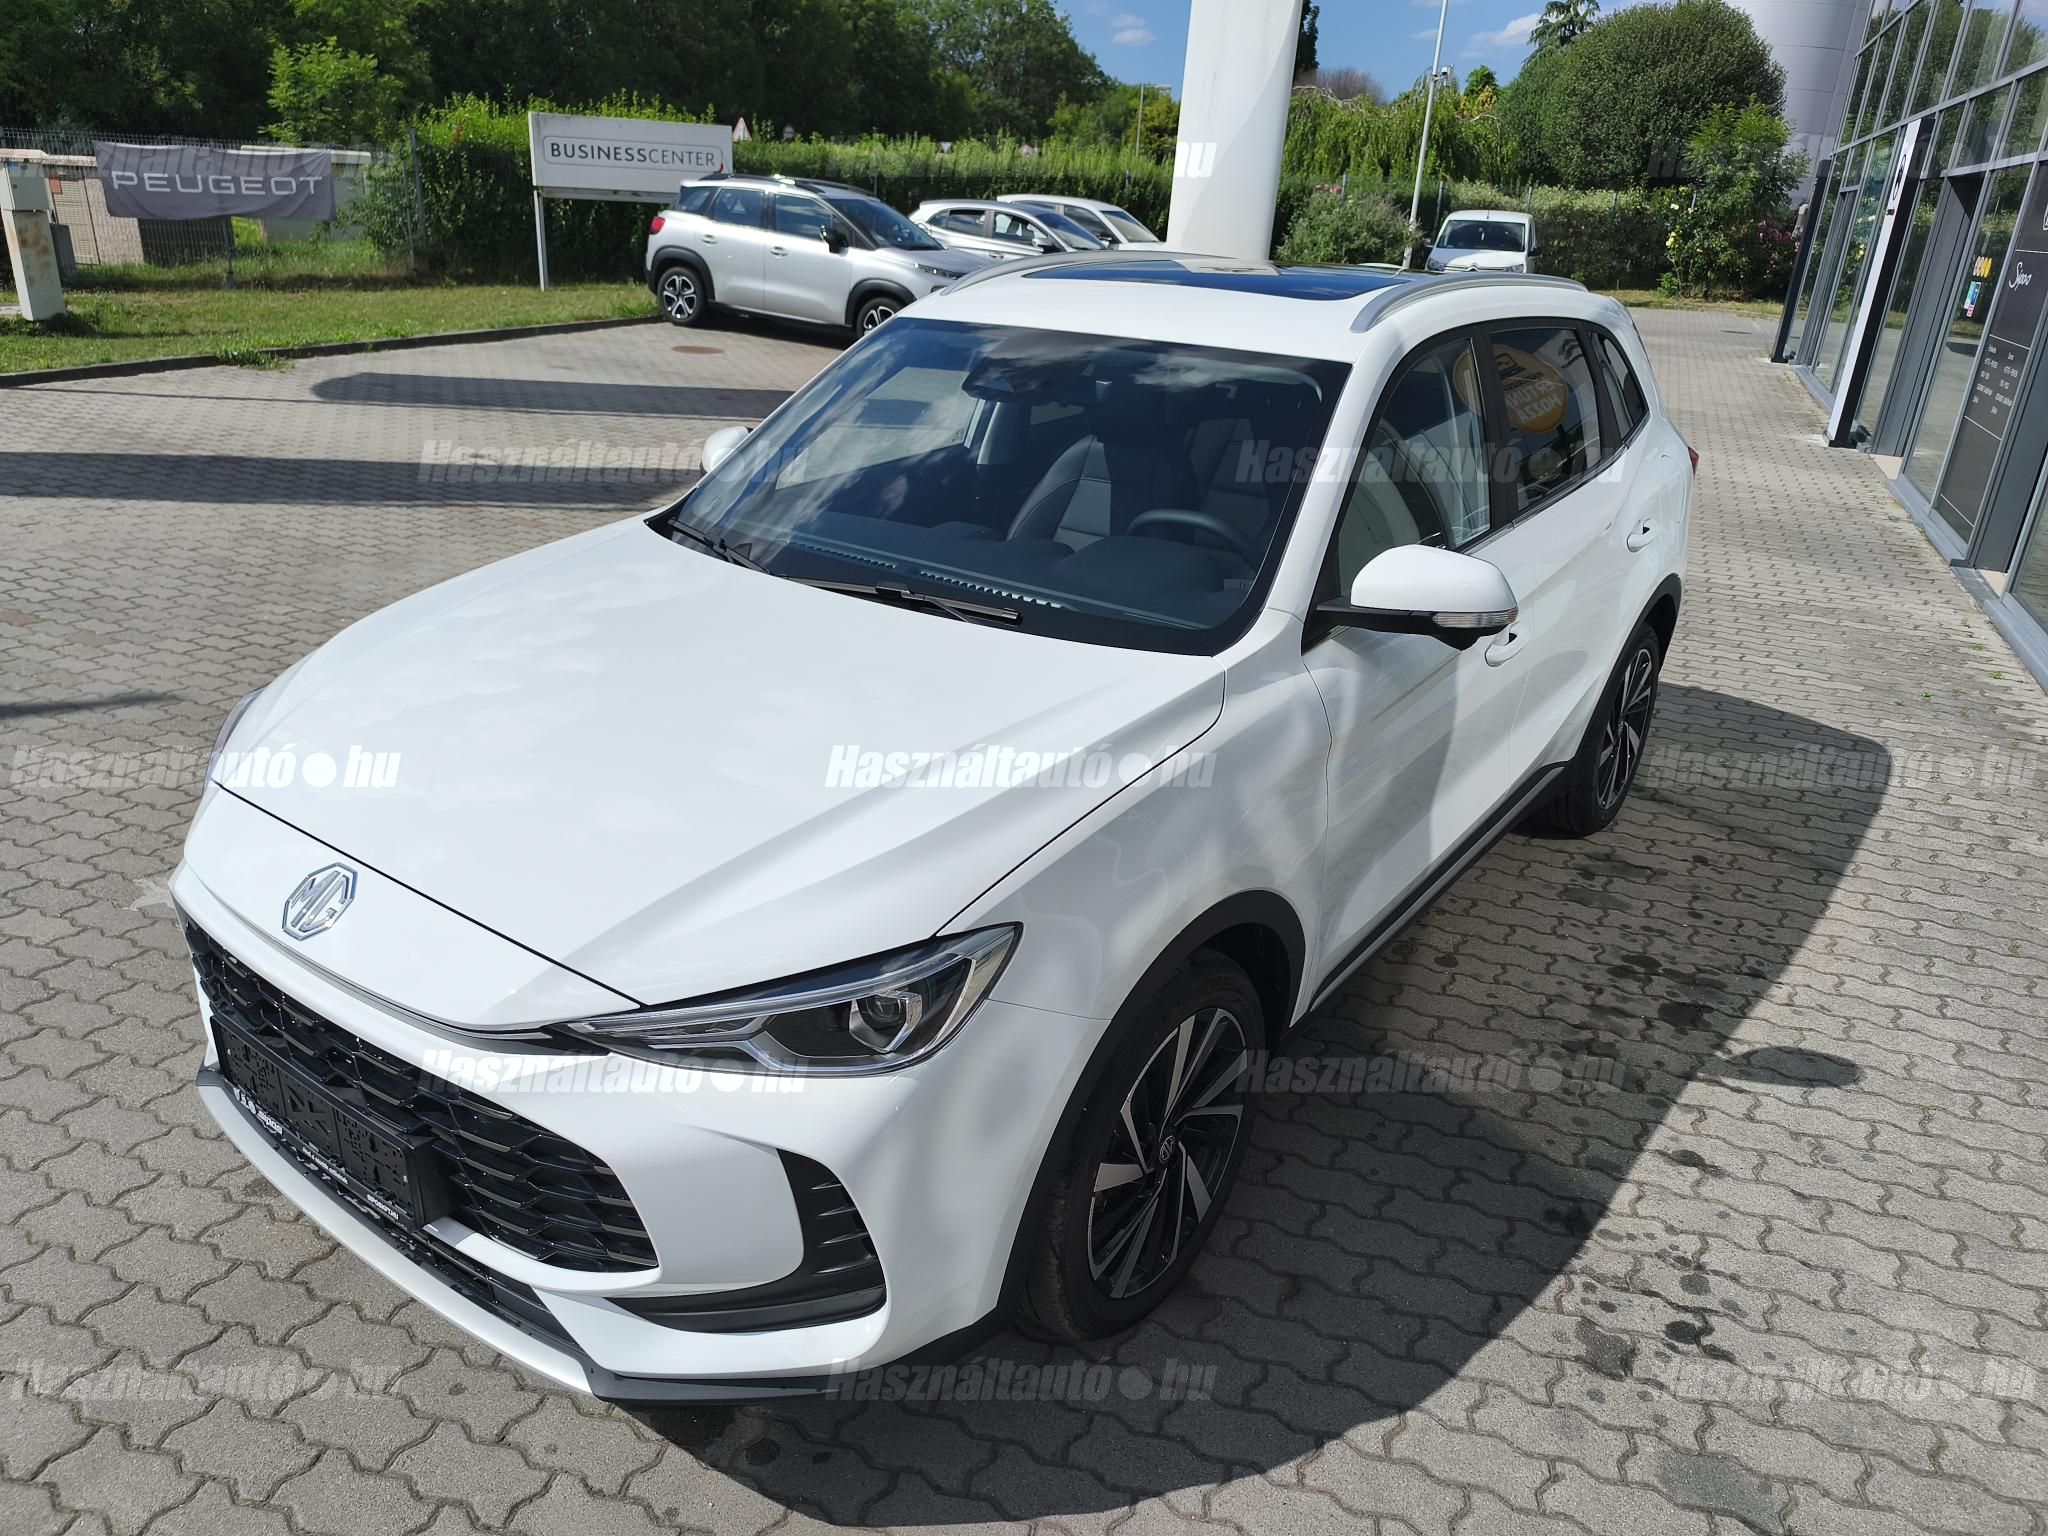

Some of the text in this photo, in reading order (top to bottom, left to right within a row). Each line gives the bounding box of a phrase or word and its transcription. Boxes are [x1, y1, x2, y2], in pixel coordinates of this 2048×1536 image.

[551, 142, 715, 166] BUSINESSCENTER
[112, 170, 323, 196] PEUGEOT
[286, 867, 353, 936] MG
